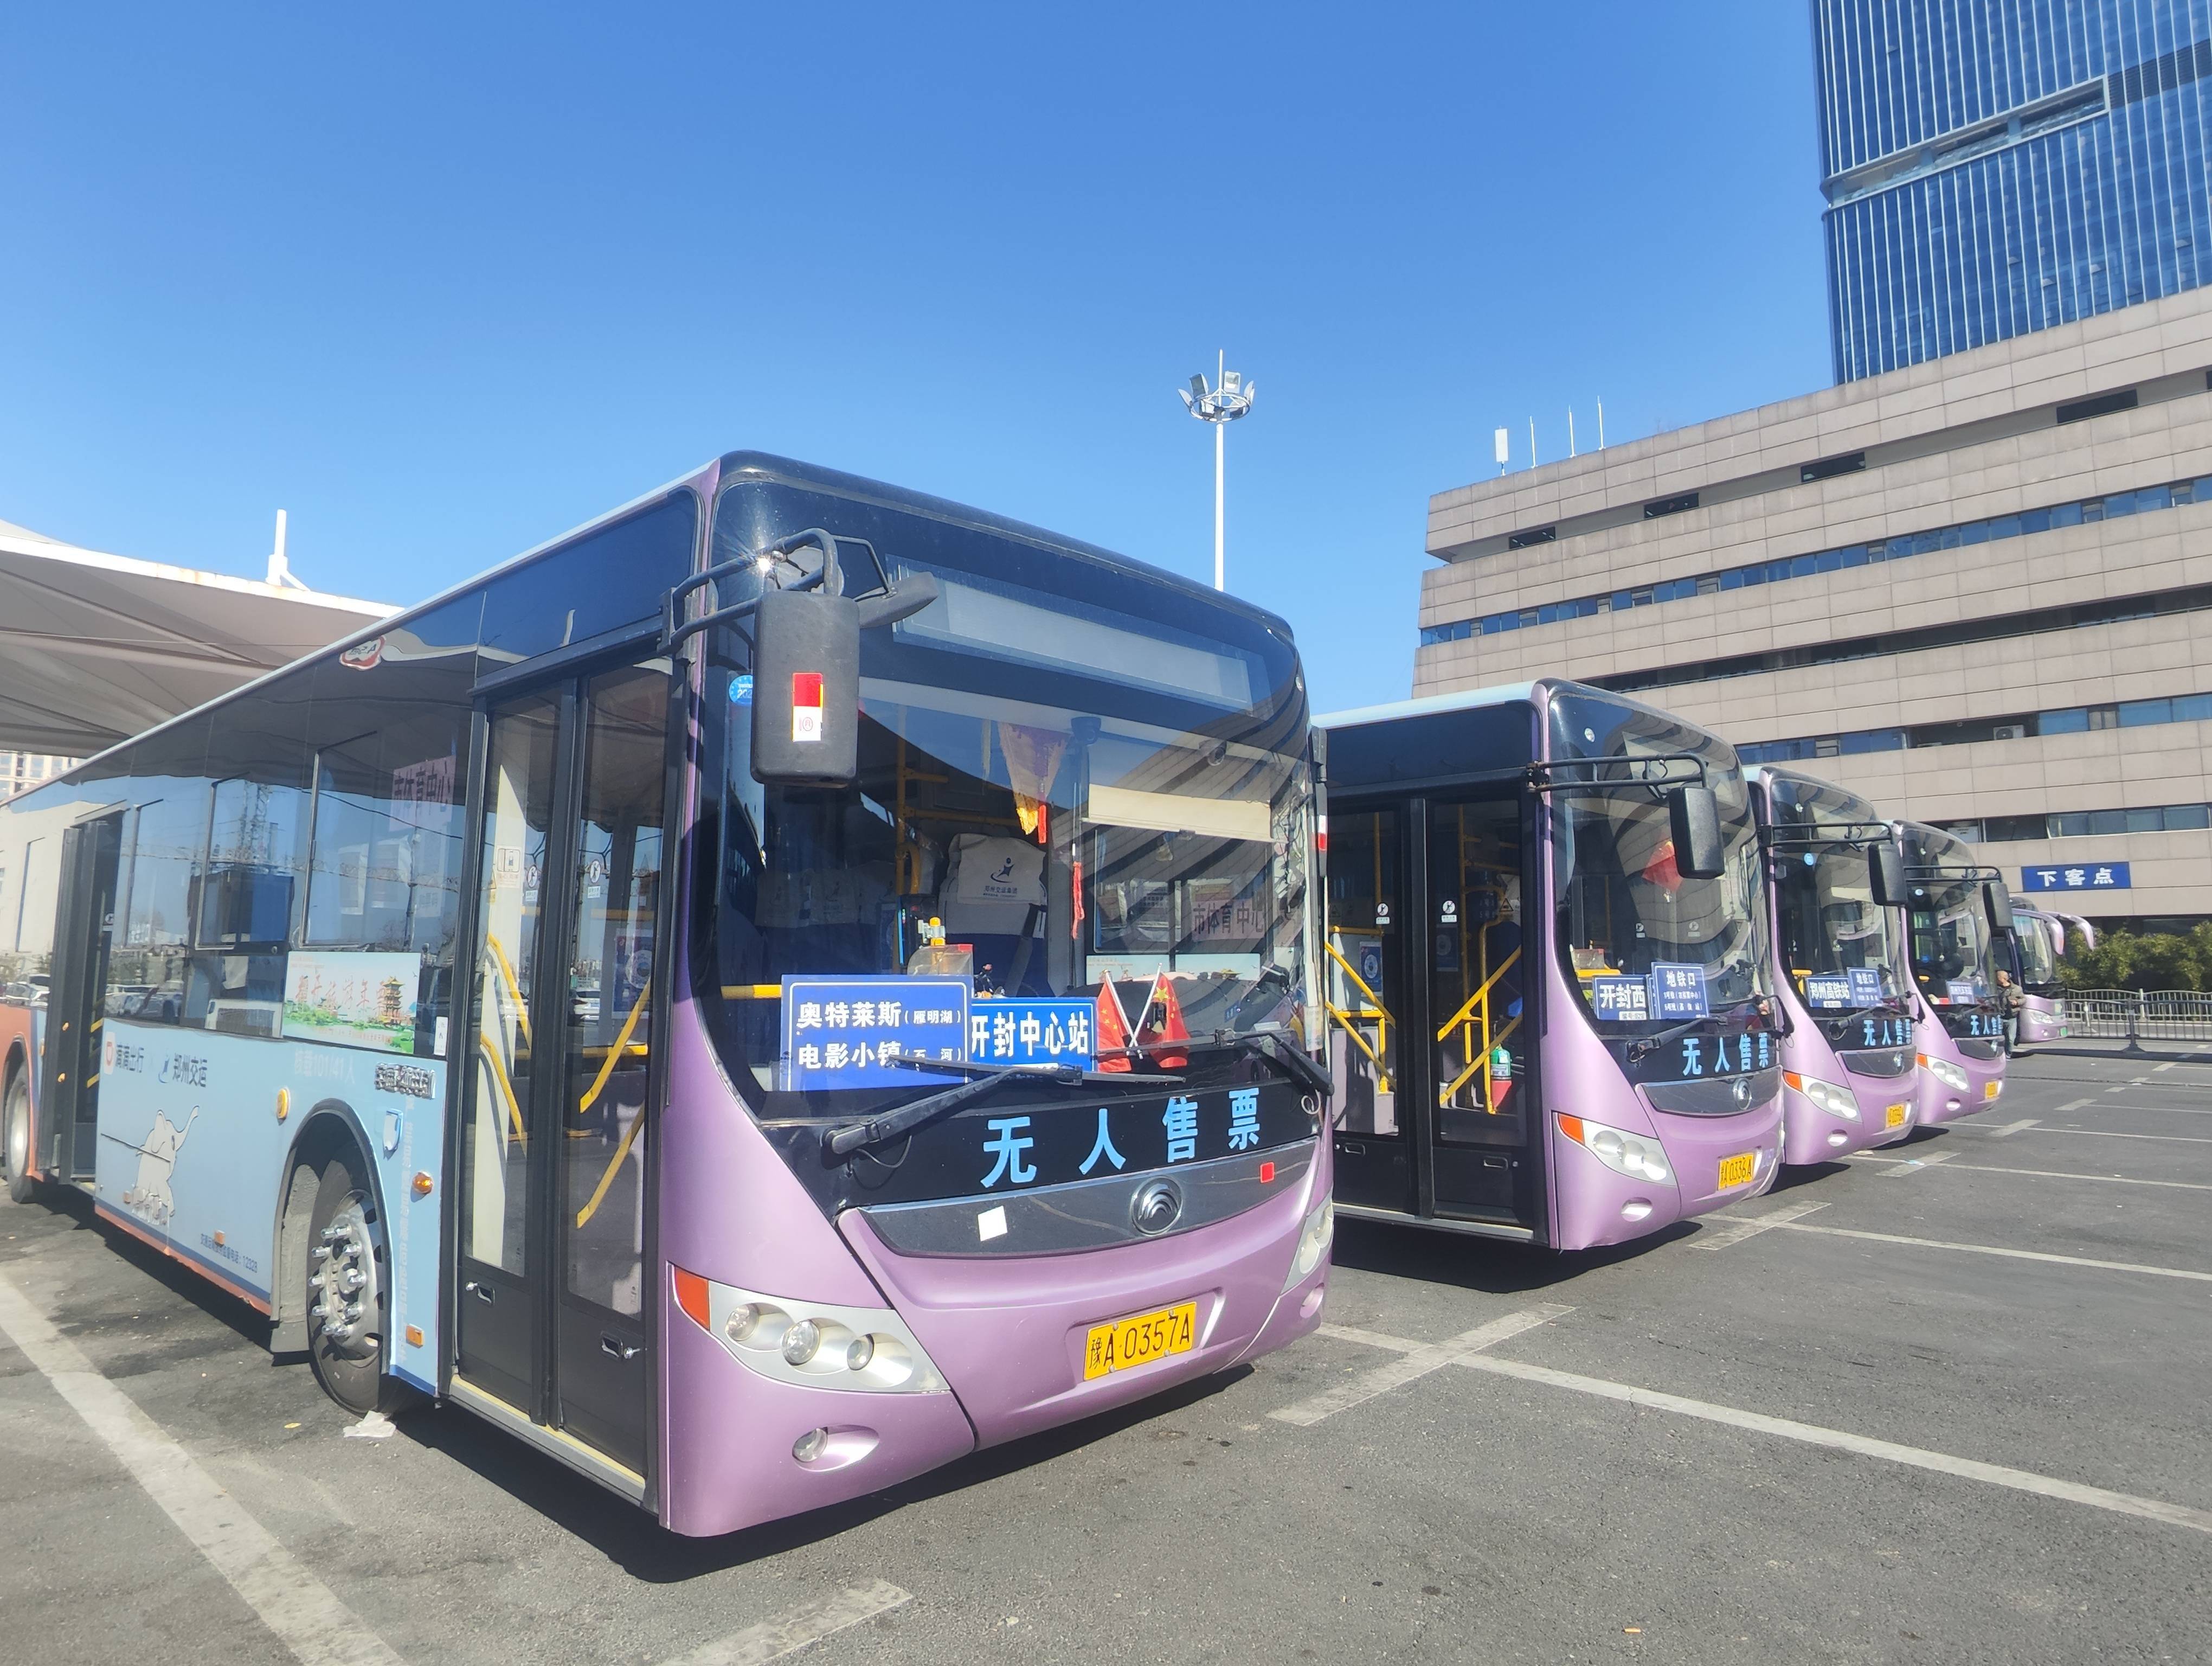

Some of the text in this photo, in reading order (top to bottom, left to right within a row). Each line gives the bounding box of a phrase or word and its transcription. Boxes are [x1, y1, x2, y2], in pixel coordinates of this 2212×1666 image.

[2037, 867, 2114, 887] 下客点
[1666, 970, 1696, 987] 地铁口
[1599, 983, 1646, 1009] 开封西
[972, 1011, 1088, 1057] 开封中心站
[1863, 1018, 1911, 1046] 无人售票
[1682, 1032, 1769, 1076] 无人售票
[980, 1087, 1261, 1188] 无人售票
